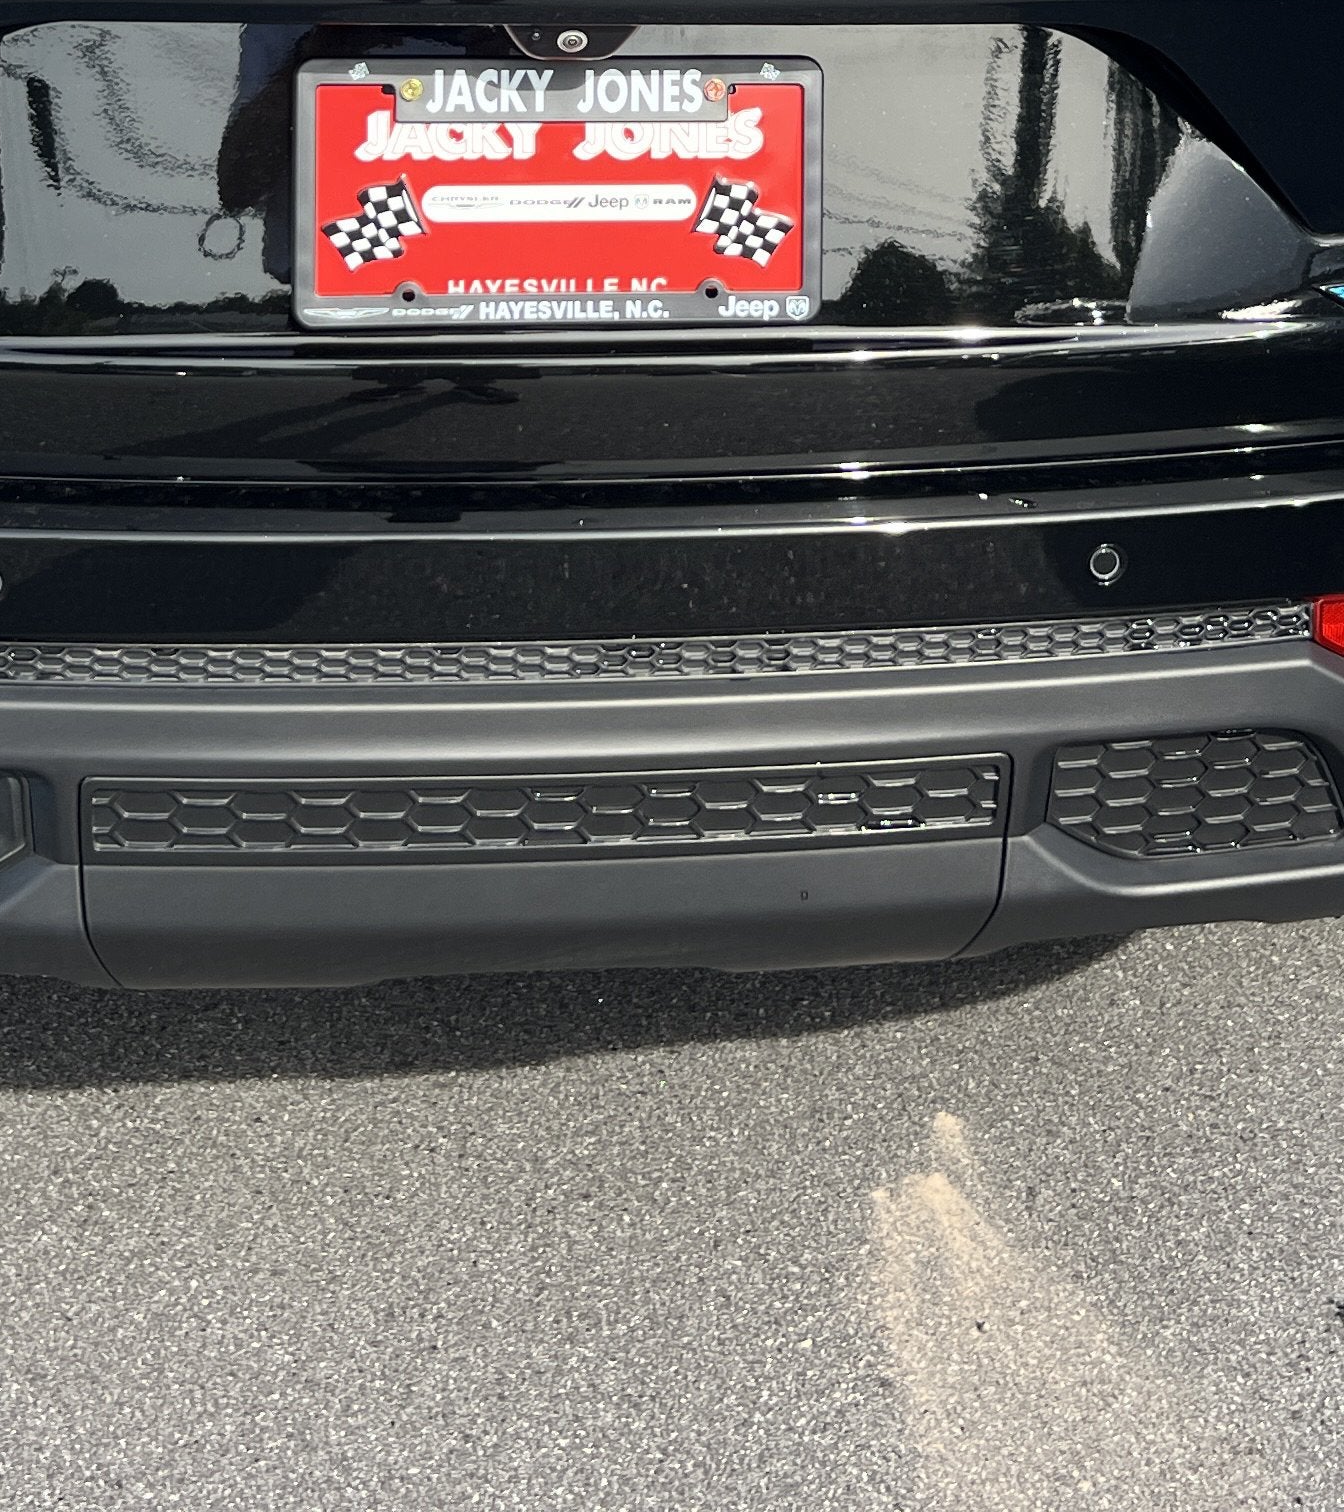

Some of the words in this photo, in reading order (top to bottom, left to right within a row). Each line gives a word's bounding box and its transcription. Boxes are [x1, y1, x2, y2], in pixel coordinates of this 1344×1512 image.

[425, 68, 553, 114] JACKY
[577, 68, 702, 114] JONES
[353, 109, 544, 161] JACKY
[571, 106, 766, 161] JONES
[588, 194, 630, 210] Jeep
[478, 300, 621, 322] HAYESVILLE,
[625, 299, 671, 320] N.C.
[718, 295, 780, 320] Jeep
